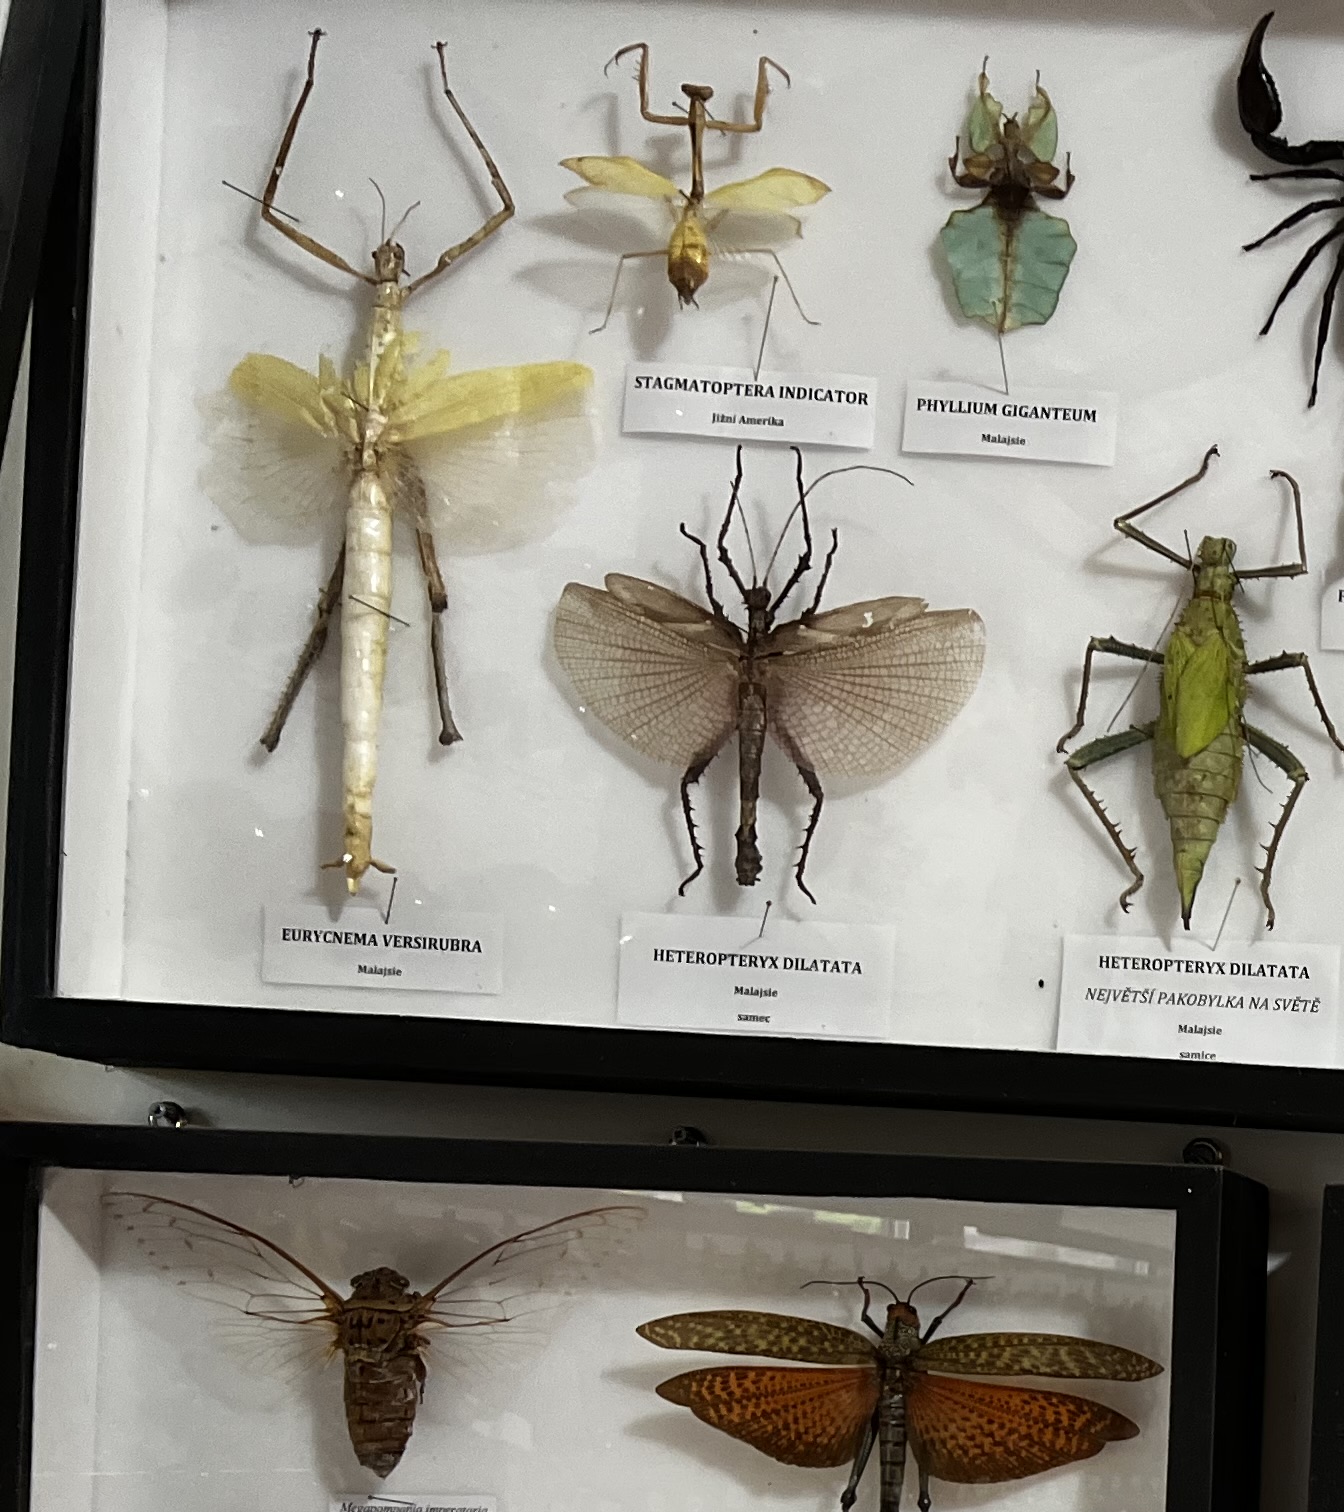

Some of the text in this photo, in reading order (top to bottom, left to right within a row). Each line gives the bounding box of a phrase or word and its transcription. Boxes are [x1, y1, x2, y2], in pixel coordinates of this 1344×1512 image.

[634, 375, 869, 406] STAGMATOPTERA INDICATOR
[917, 398, 1097, 423] PHYLLIUM GIGANTEUM
[712, 412, 785, 427] Jižní Amerika
[980, 433, 1026, 447] Malajsie
[281, 927, 483, 954] EURYCNEMA VERSIRUBRA
[654, 948, 864, 976] HETEROPTERYX DILATATA
[1098, 955, 1311, 980] HETEROPTERYX DILATATA
[357, 964, 403, 977] Malajsie
[735, 985, 779, 999] Malajsie
[1085, 986, 1321, 1013] NEJVĚTŠÍ PAKOBYLKA NA SVĚTĚ
[738, 1013, 772, 1024] samec
[1178, 1023, 1223, 1036] Malajsie
[1178, 1049, 1217, 1060] samice
